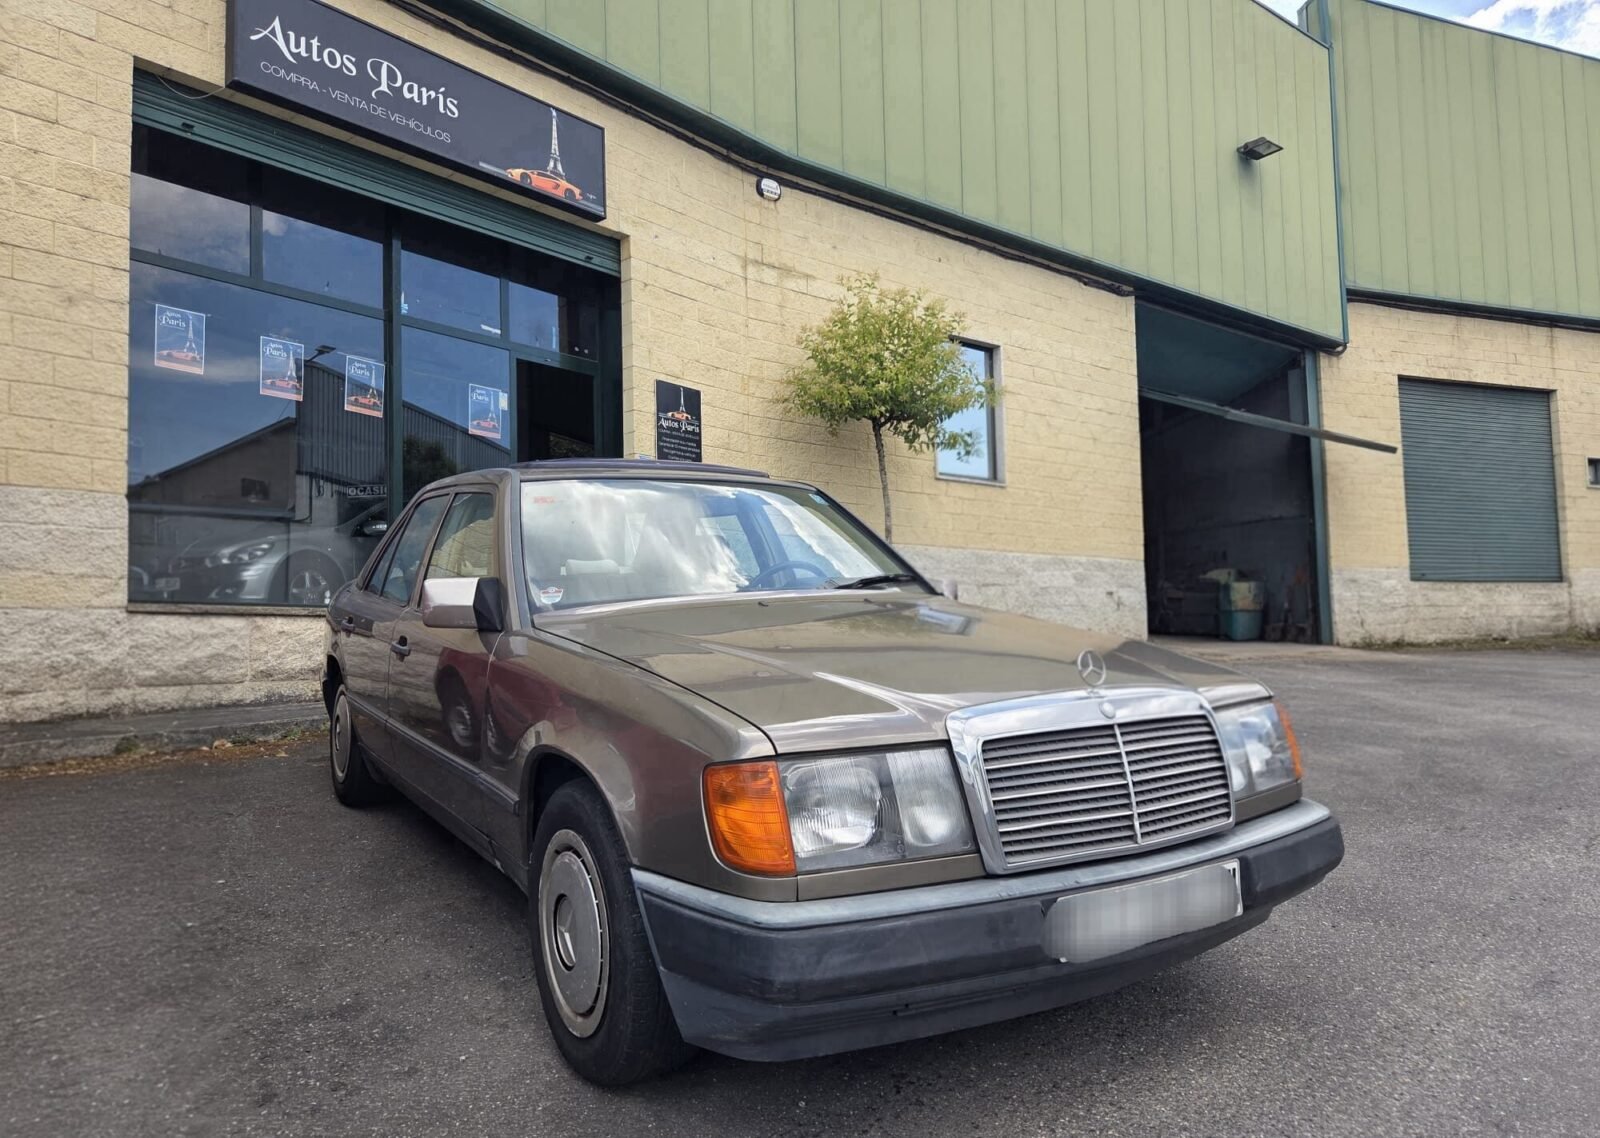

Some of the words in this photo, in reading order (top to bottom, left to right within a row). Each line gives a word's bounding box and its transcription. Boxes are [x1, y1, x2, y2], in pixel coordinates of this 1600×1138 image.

[249, 15, 357, 76] Autos
[366, 58, 459, 118] París
[260, 61, 320, 93] COMPRA
[328, 87, 369, 112] VENTA
[370, 103, 387, 119] DE
[388, 110, 451, 143] VEHÍCULOS
[658, 417, 679, 429] Autos
